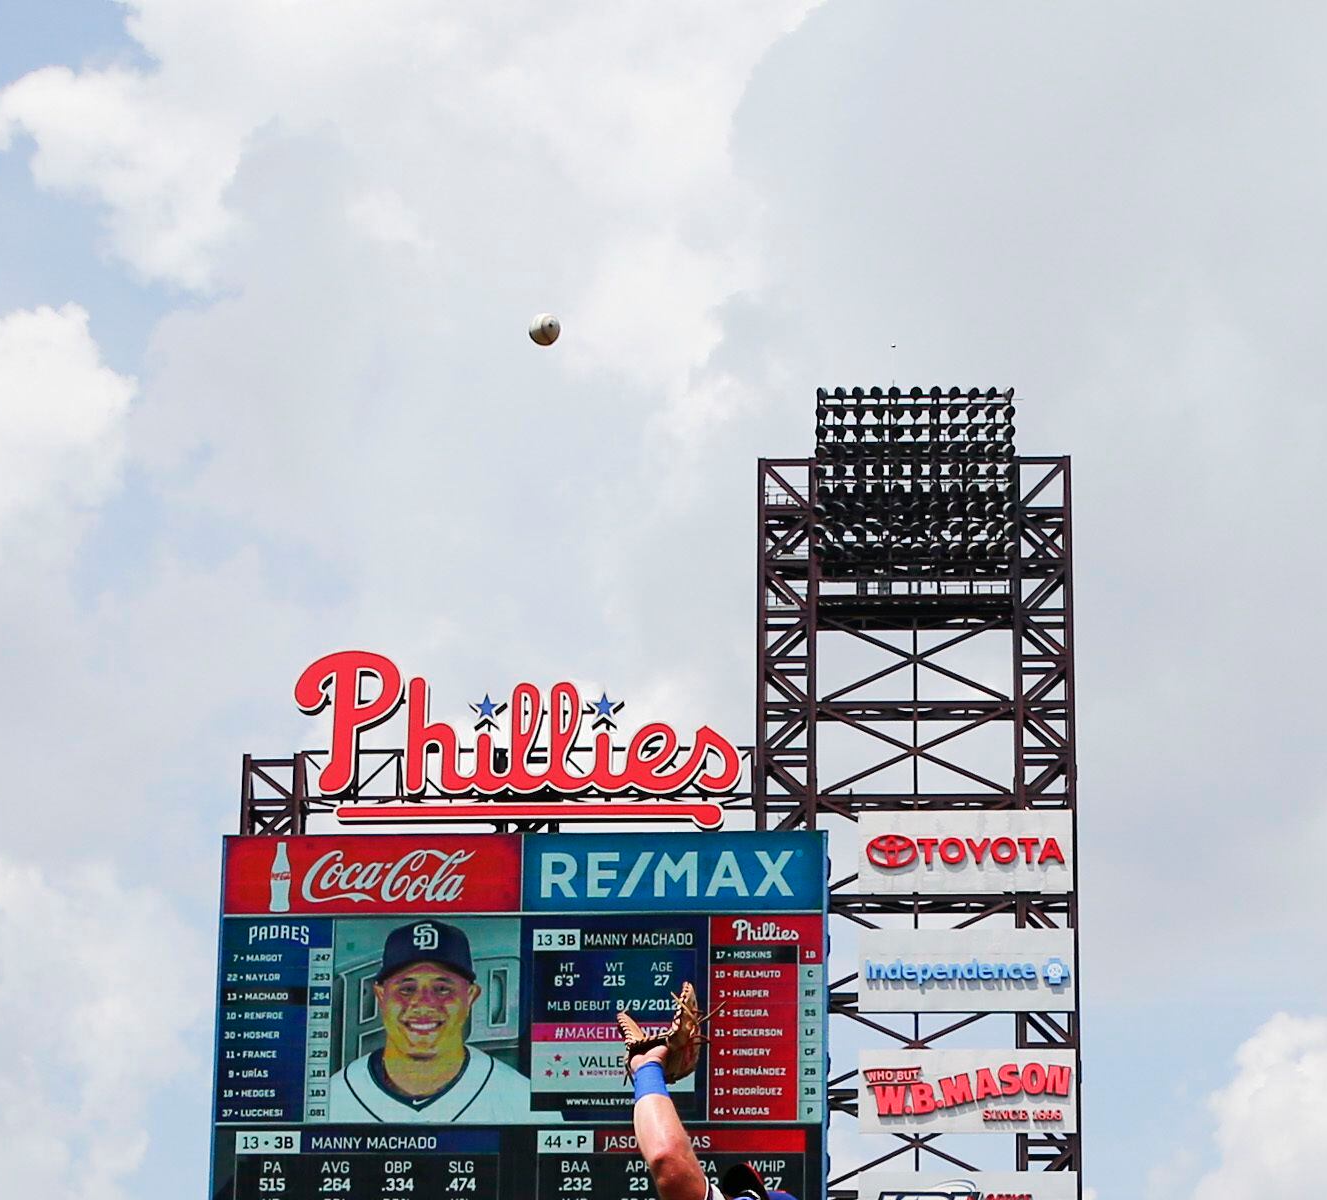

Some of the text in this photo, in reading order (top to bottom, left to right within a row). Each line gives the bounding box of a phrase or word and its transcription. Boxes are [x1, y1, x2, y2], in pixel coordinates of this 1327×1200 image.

[295, 649, 742, 794] Phillies
[917, 837, 1065, 864] TOYOTA
[302, 850, 476, 902] Coca-Cola
[540, 851, 794, 898] RE/MAX
[248, 924, 309, 945] PADRES
[732, 919, 799, 942] Phillies
[537, 933, 693, 946] 13 3B MANNY MACHADO
[246, 953, 282, 962] MARGOT
[733, 950, 772, 959] HOSKINS
[560, 962, 673, 972] HT WT AGE
[865, 959, 1036, 985] Independence
[245, 973, 281, 982] NAYLOR
[733, 970, 780, 978] REALMUTO
[603, 975, 625, 987] 215
[654, 974, 669, 986] 27
[244, 992, 289, 1001] MACHADO
[733, 989, 769, 998] HARPER
[547, 1000, 572, 1011] MLB
[574, 1000, 610, 1011] DEBUT
[244, 1011, 283, 1020] RENFROE
[733, 1009, 768, 1018] SEGURA
[243, 1031, 280, 1040] HOSMER
[733, 1028, 783, 1037] DICKERSON
[242, 1050, 277, 1059] FRANCE
[733, 1048, 771, 1057] KINGERY
[242, 1068, 268, 1078] URÍAS
[732, 1065, 786, 1076] HERNÁNDEZ
[867, 1069, 919, 1082] WHO BUT
[241, 1089, 275, 1098] HEDGES
[732, 1085, 783, 1096] RODRÍGUEZ
[240, 1109, 283, 1117] LUCCHESI
[732, 1106, 770, 1115] VARGAS
[983, 1109, 1028, 1121] SINCE
[242, 1136, 437, 1150] 13 3B MANNY MACHADO
[544, 1135, 586, 1148] 44 P
[263, 1161, 474, 1174] PA AVG OBP SLG
[561, 1161, 590, 1173] BAA
[259, 1177, 476, 1192] 515 .264 .334 .474
[558, 1178, 592, 1191] .232
